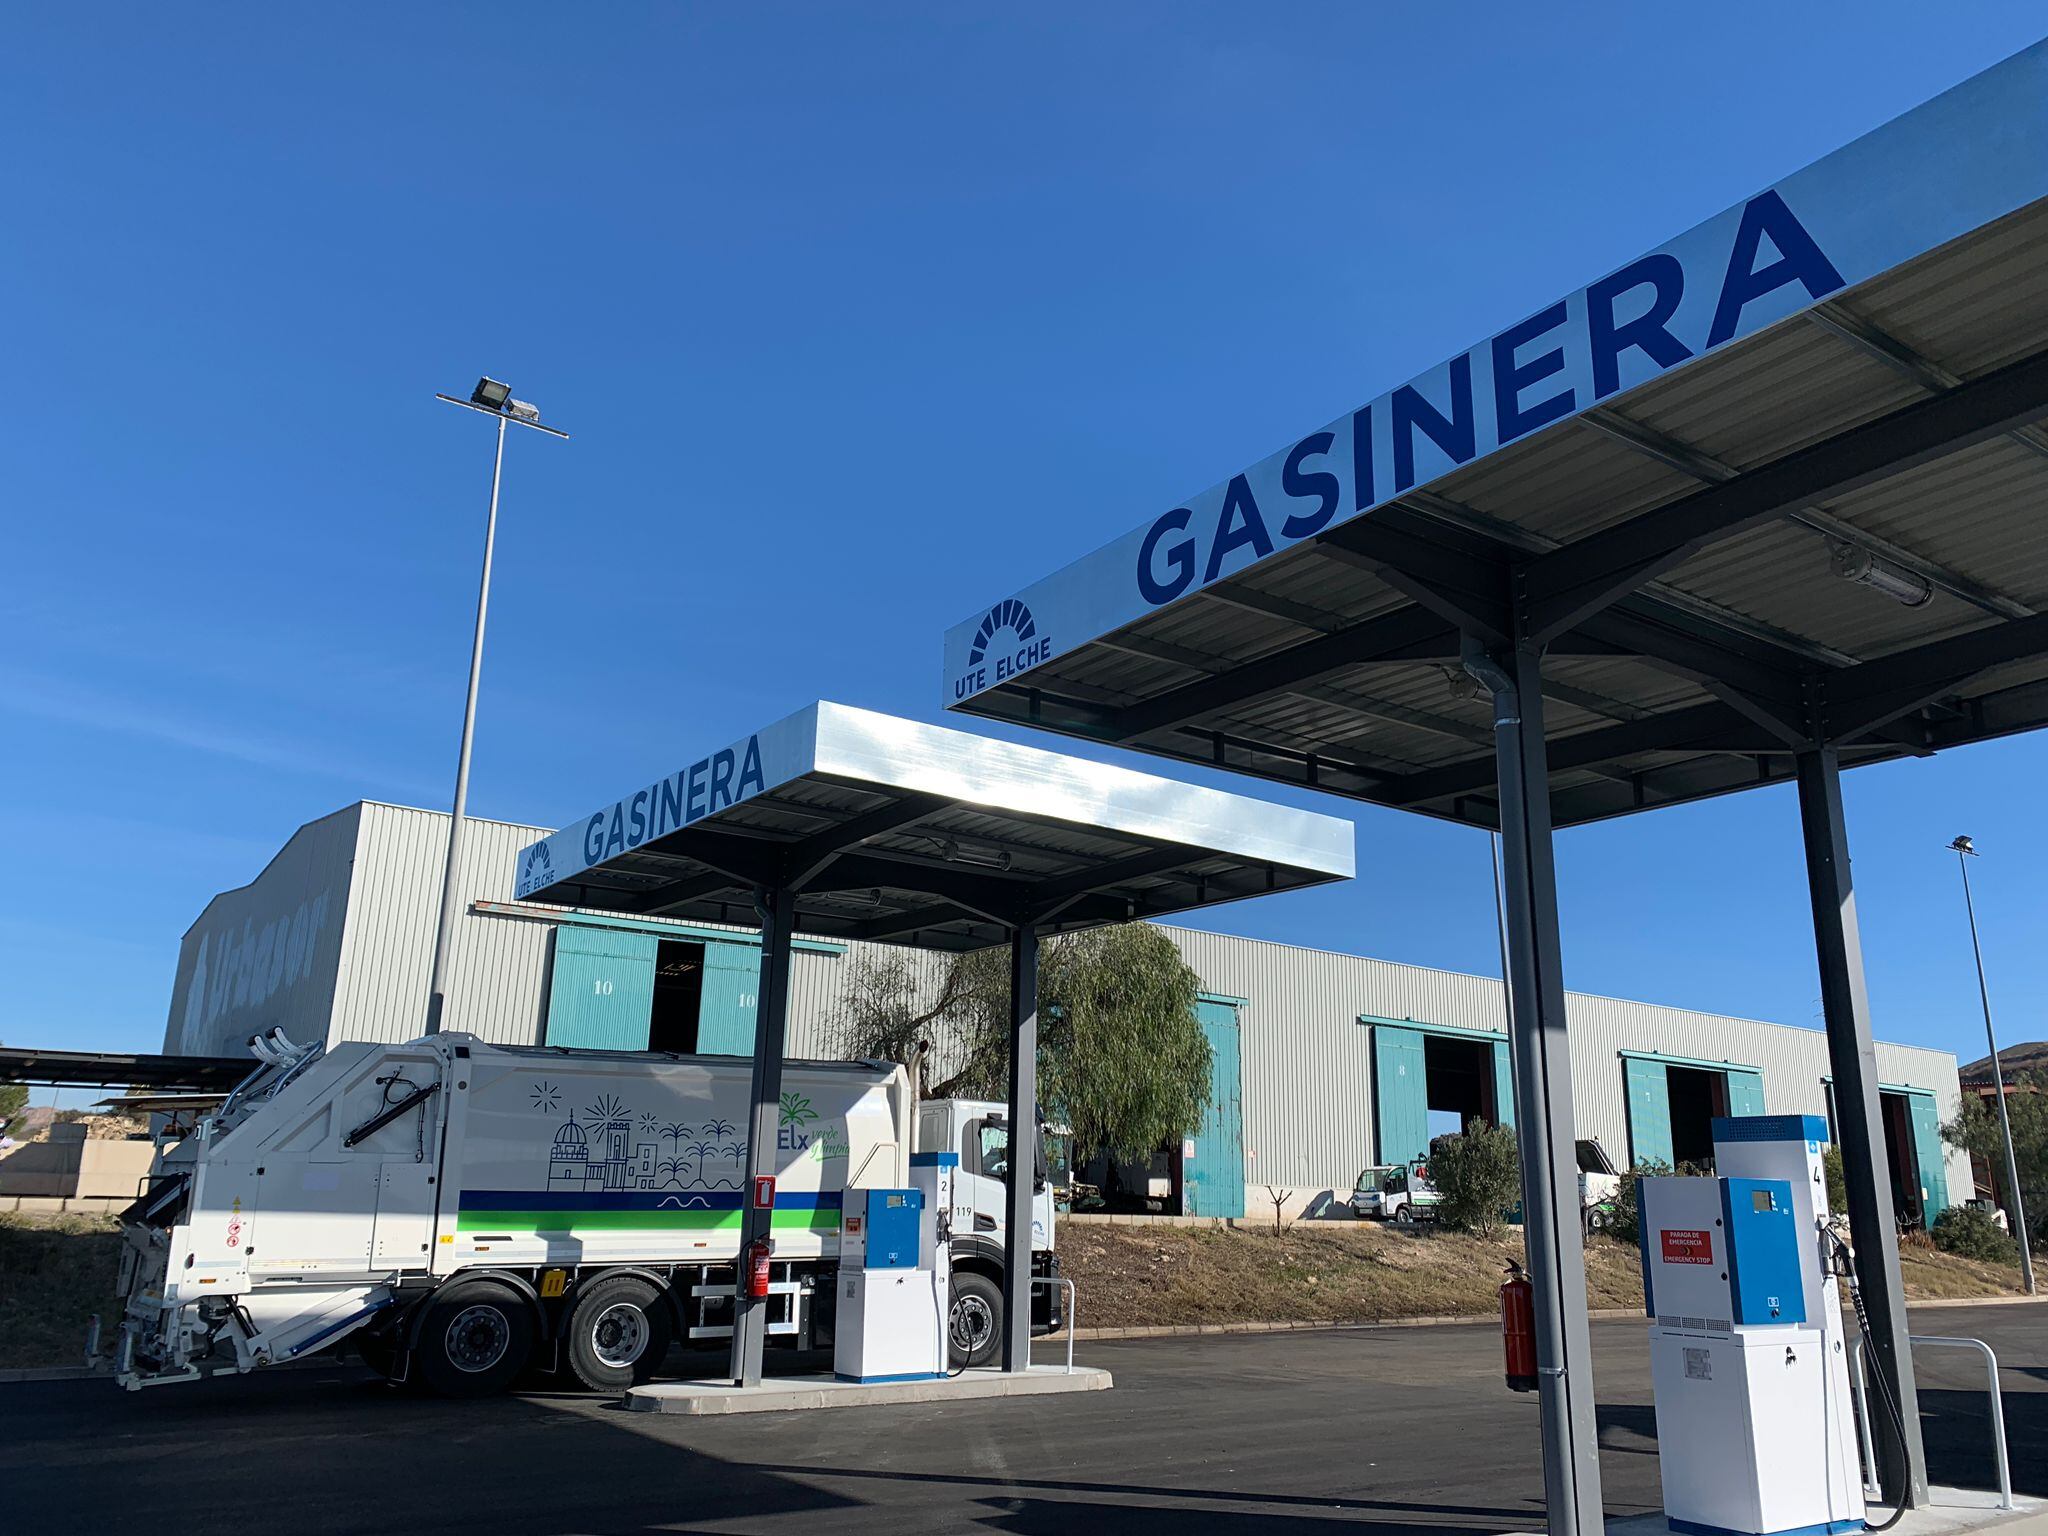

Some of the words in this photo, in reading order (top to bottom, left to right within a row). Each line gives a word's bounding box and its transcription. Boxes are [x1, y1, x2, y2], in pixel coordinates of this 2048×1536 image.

[1136, 188, 1848, 606] GASINERA
[955, 667, 986, 699] UTE
[996, 636, 1051, 681] ELCHE
[583, 733, 765, 867] GASINERA
[518, 879, 531, 896] UTE
[533, 869, 555, 890] ELCHE
[594, 980, 613, 995] 10
[739, 993, 756, 1008] 10
[777, 1124, 809, 1150] Elx
[811, 1125, 838, 1139] verde
[1813, 1165, 1821, 1185] 4
[941, 1180, 948, 1192] 2
[956, 1206, 972, 1217] 119
[1669, 1231, 1692, 1239] PARADA
[1664, 1255, 1696, 1263] EMERGENCY
[1696, 1256, 1711, 1264] STOP
